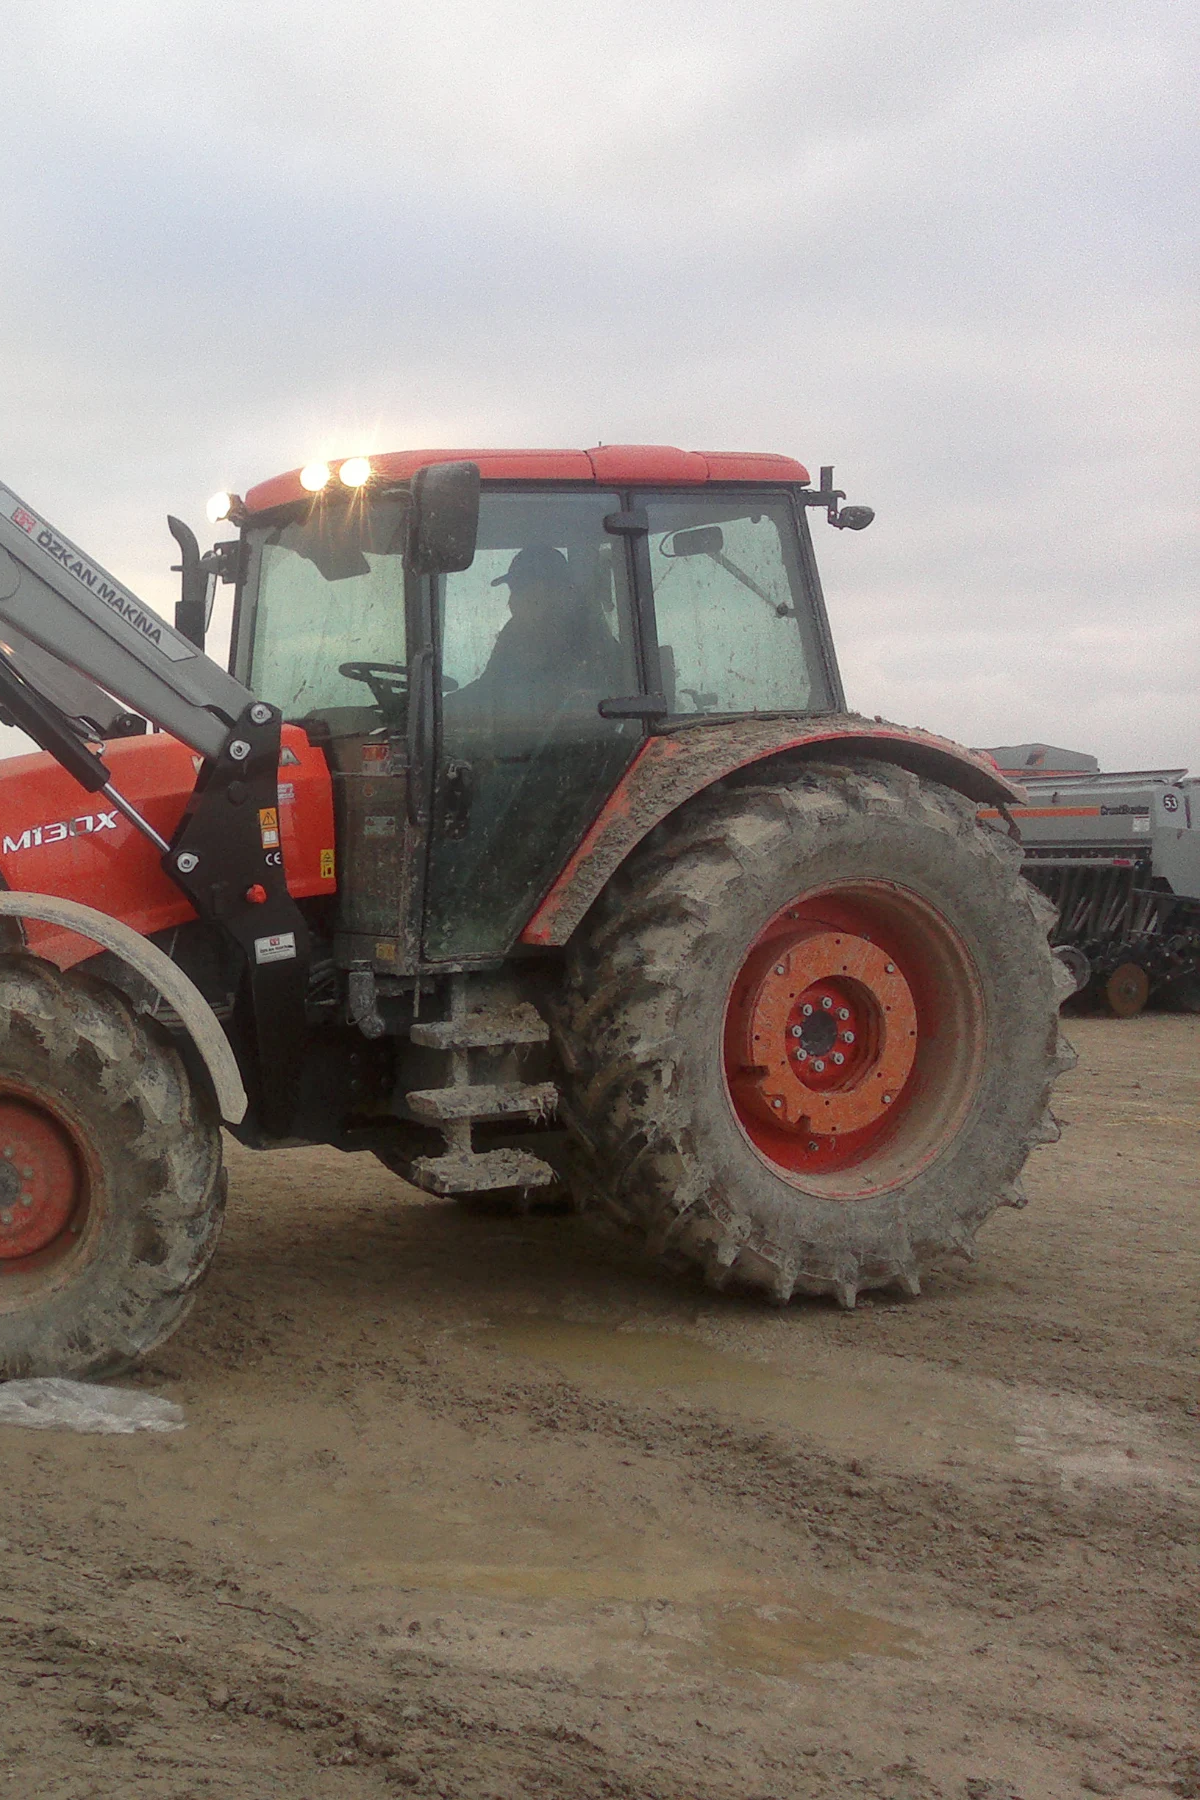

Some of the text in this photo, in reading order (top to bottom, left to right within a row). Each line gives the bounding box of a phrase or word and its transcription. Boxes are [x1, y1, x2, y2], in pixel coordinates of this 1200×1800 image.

[36, 530, 98, 587] ÖZKAN
[2, 809, 119, 855] M130X
[265, 851, 282, 866] CE
